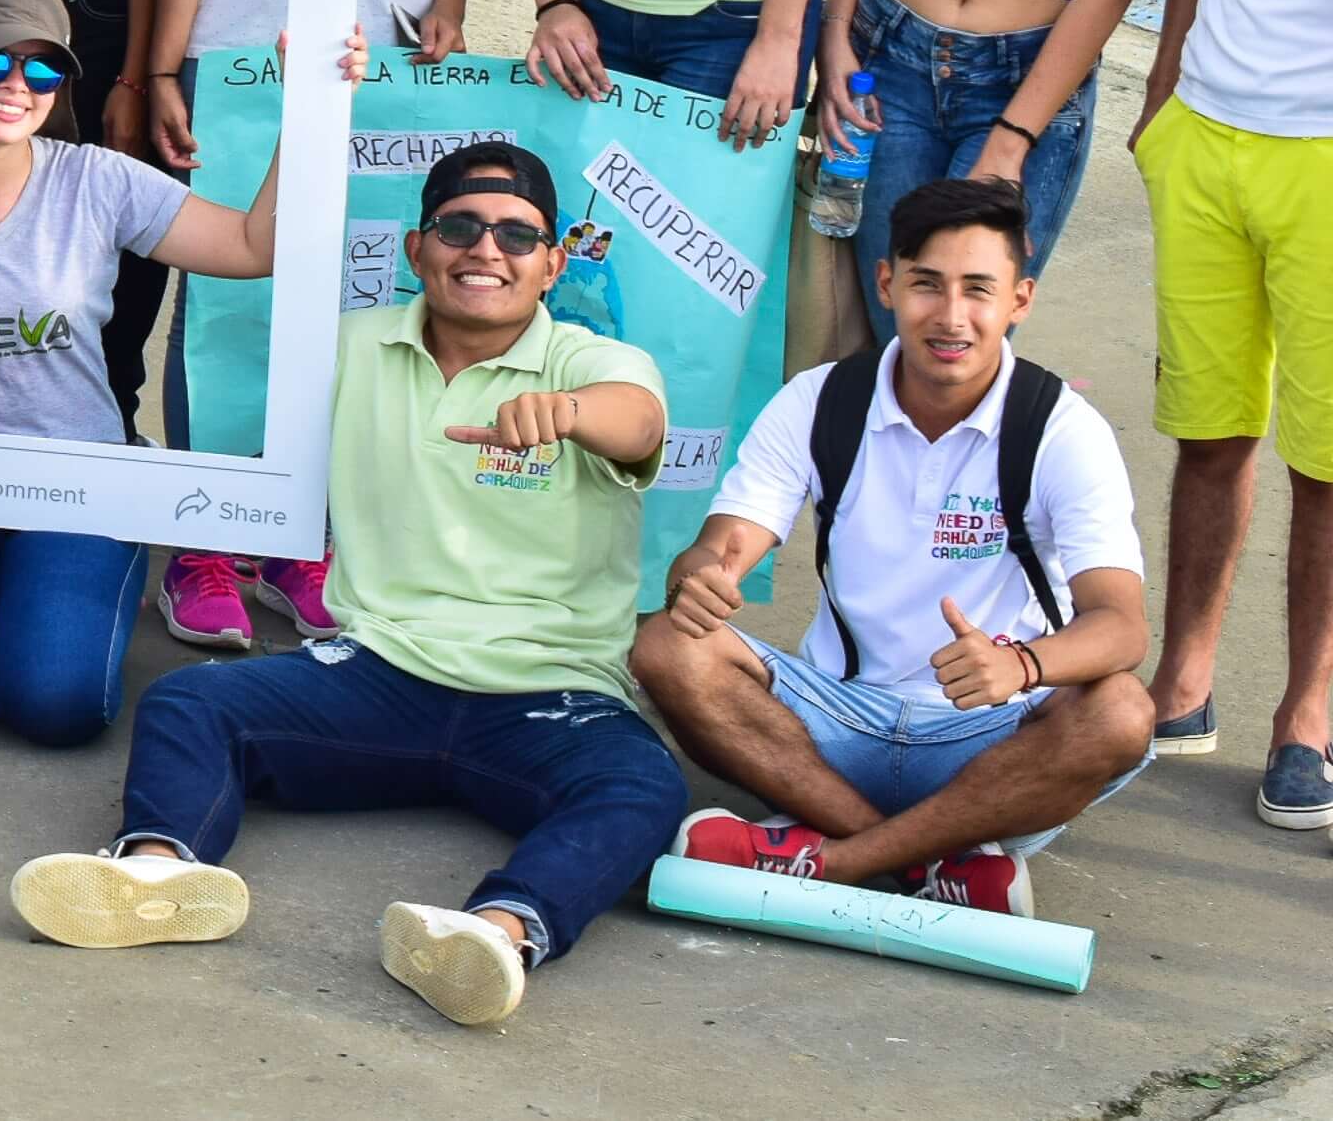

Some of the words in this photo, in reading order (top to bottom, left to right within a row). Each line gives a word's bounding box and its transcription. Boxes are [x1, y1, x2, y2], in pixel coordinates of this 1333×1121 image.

[635, 87, 668, 118] DE
[350, 131, 507, 168] RECHAZ
[596, 152, 757, 311] RECUPERAR
[528, 462, 552, 477] DE
[219, 501, 287, 526] Share
[936, 513, 983, 529] NEED
[983, 531, 1005, 543] DE
